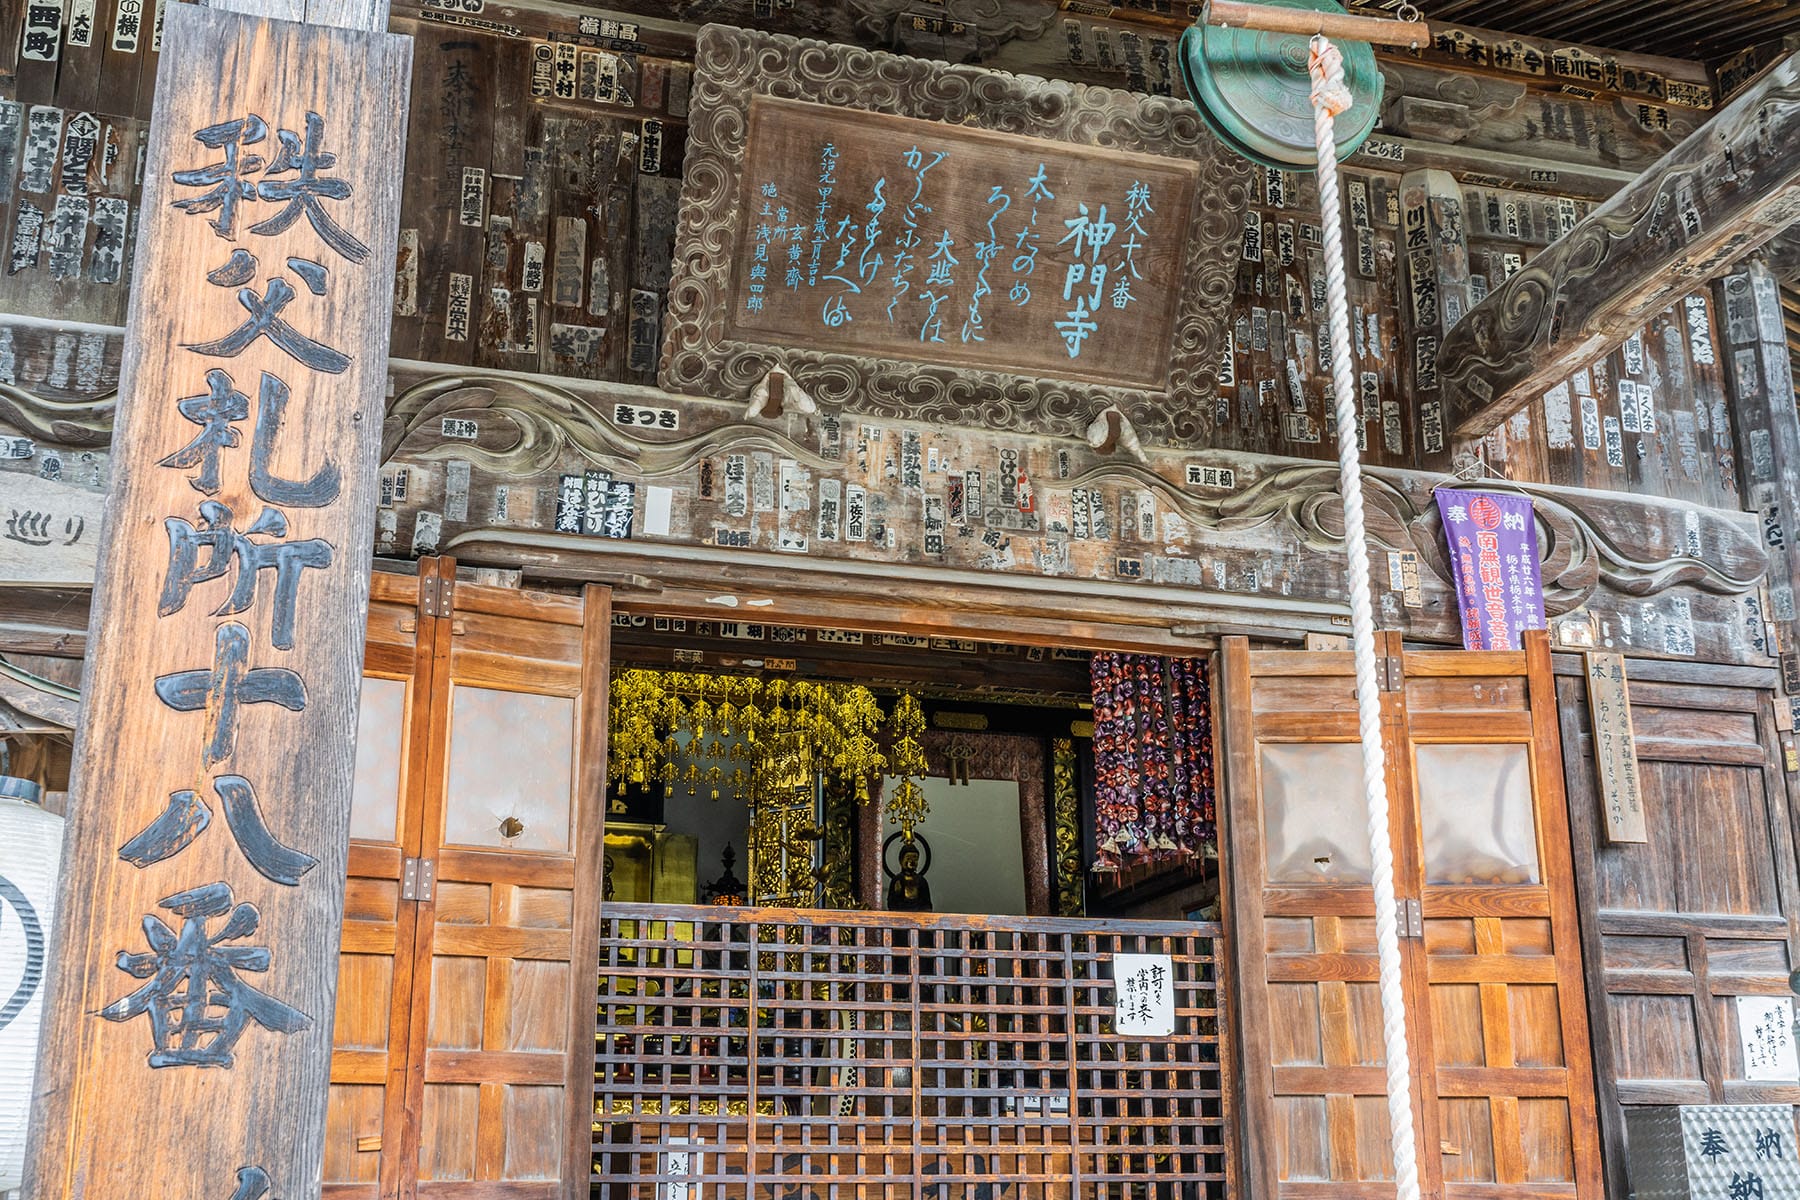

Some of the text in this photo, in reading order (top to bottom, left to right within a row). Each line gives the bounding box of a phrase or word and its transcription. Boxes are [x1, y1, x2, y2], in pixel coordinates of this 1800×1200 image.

[25, 5, 62, 59] 西町
[1110, 180, 1155, 309] 秩父十八番
[1407, 206, 1428, 247] 川辰
[1054, 202, 1117, 359] 神門寺
[3, 508, 84, 546] 巡り
[849, 504, 864, 538] 佐久間
[1446, 504, 1526, 533] 奉 納
[93, 110, 371, 1070] 秩父札所十八番
[1475, 531, 1512, 651] 南無観世音菩薩
[1505, 553, 1523, 616] 栃木県栃木市
[1519, 542, 1536, 597] 平成廿六年
[1592, 663, 1607, 680] 本
[1700, 1127, 1783, 1165] 奉 納
